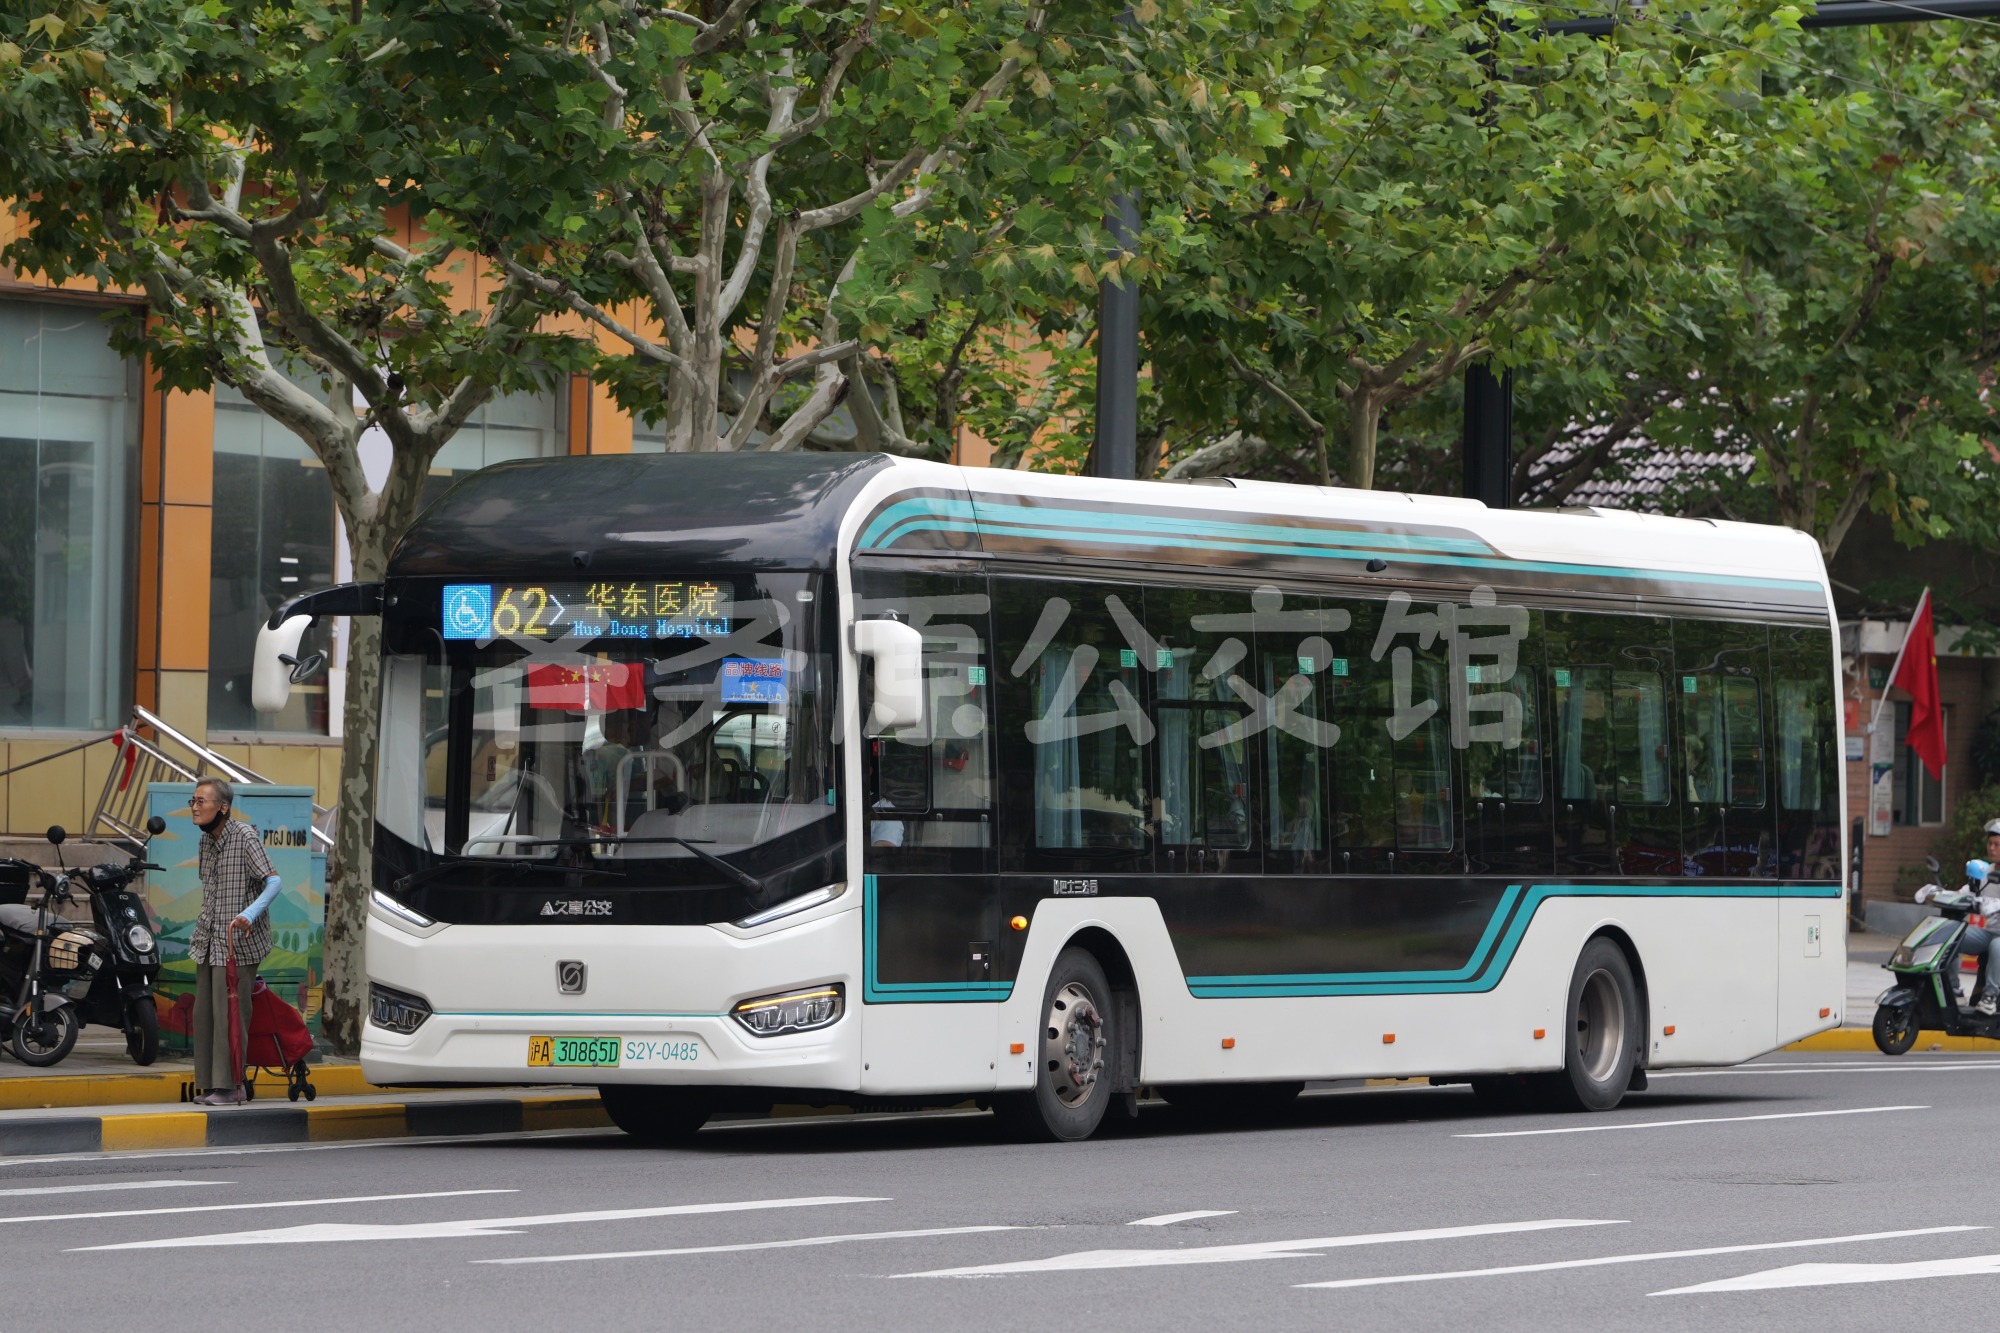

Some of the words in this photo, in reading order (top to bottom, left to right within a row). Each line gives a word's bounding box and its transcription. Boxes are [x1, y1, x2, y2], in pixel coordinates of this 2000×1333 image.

[585, 581, 718, 617] 华东医院
[493, 587, 547, 635] 62
[573, 620, 601, 636] Hua
[610, 620, 648, 639] Dong
[656, 617, 731, 639] Hospital
[725, 662, 783, 678] 品牌线路
[625, 1042, 699, 1061] S2Y-0485
